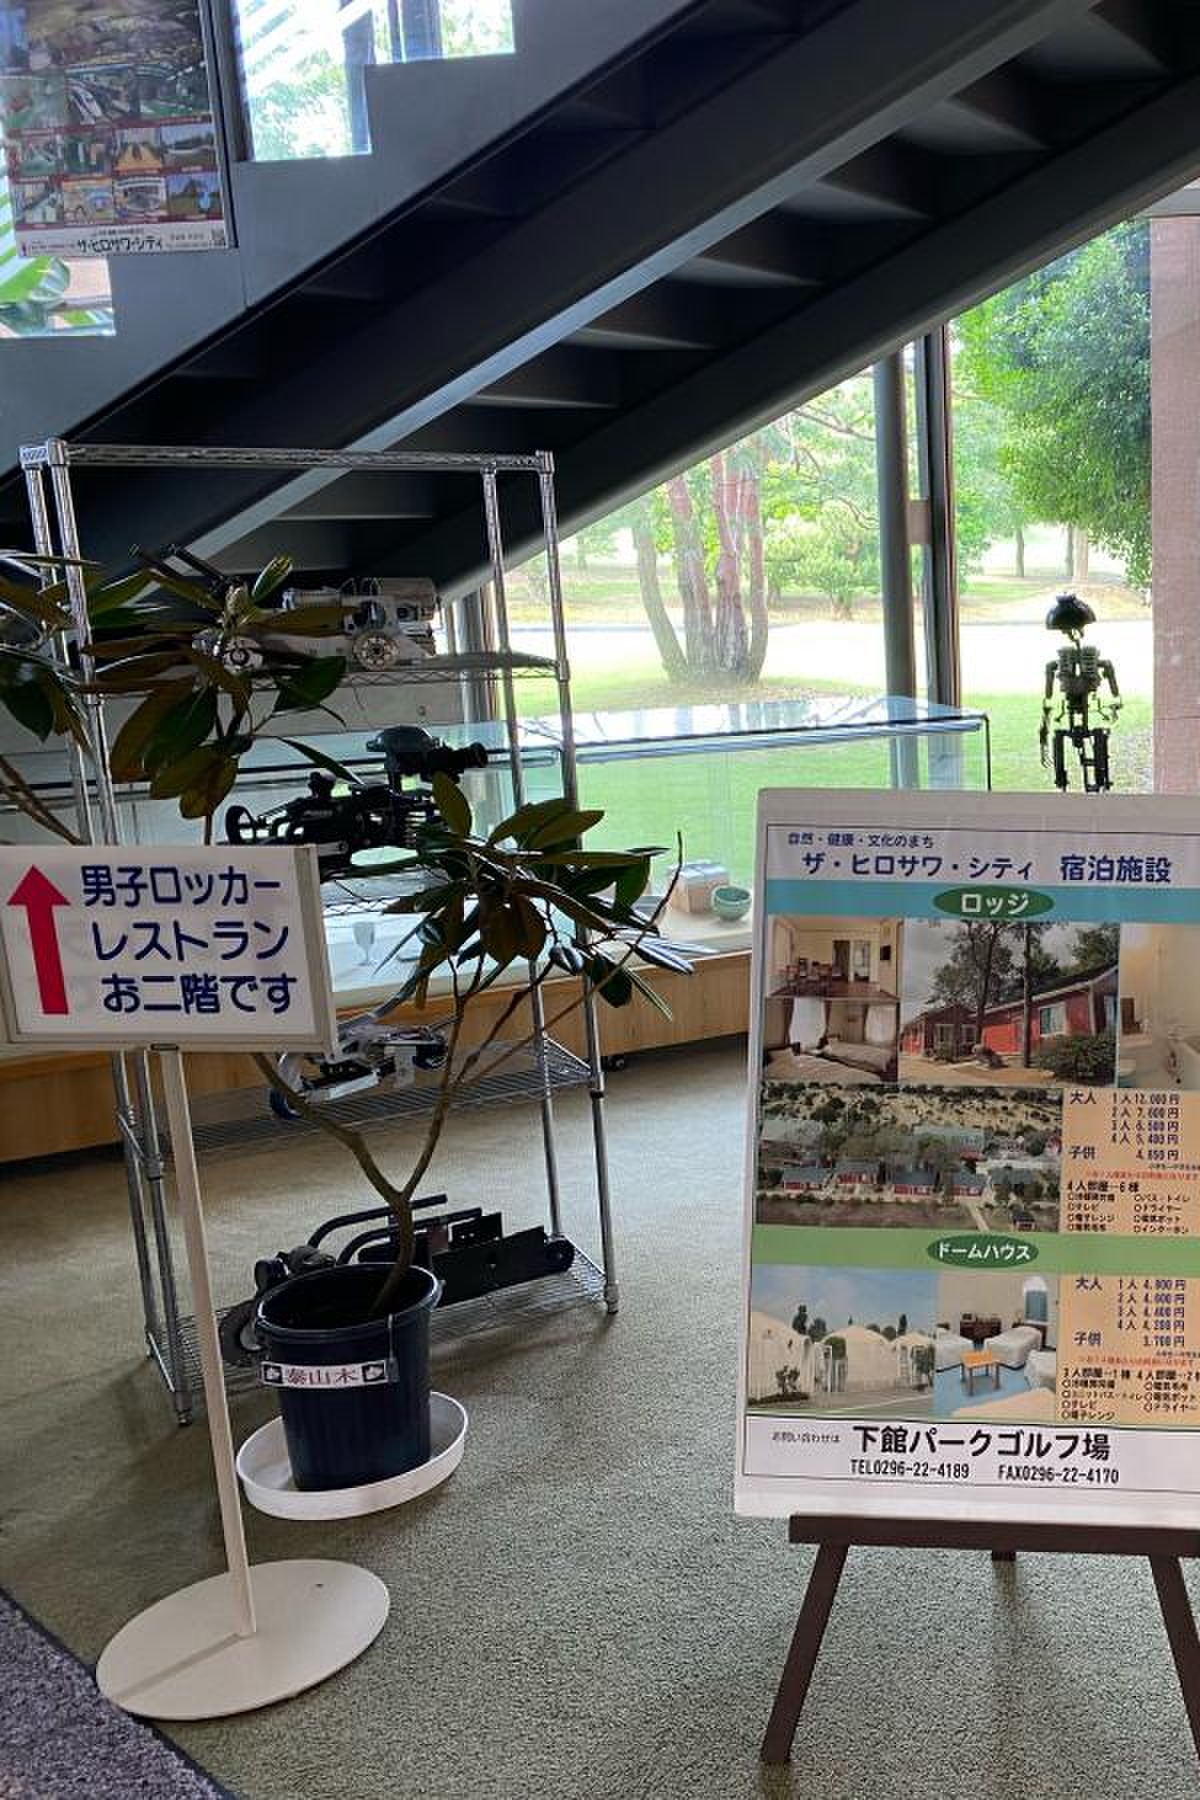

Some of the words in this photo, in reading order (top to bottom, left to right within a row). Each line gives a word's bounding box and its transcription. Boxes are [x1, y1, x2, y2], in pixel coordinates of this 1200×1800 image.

[788, 832, 934, 848] 自然・健康・文化のまち
[801, 852, 1033, 880] ザ・ヒロサワ・シティ
[1060, 855, 1172, 883] 宿泊施設
[81, 865, 281, 908] 男子ロッカー
[961, 893, 1030, 914] ロッジ
[92, 920, 289, 961] レストラン
[101, 973, 297, 1014] お二階です
[1070, 1090, 1097, 1104] 大人
[1069, 1146, 1096, 1159] 子供
[939, 1242, 1030, 1260] ドームハウス
[1076, 1278, 1102, 1291] 大人
[1074, 1331, 1101, 1346] 子供
[853, 1425, 1112, 1461] 下館パークゴルフ場
[851, 1459, 970, 1479] TEL0296-22-4189
[998, 1464, 1119, 1484] FAX0296-22-4170
